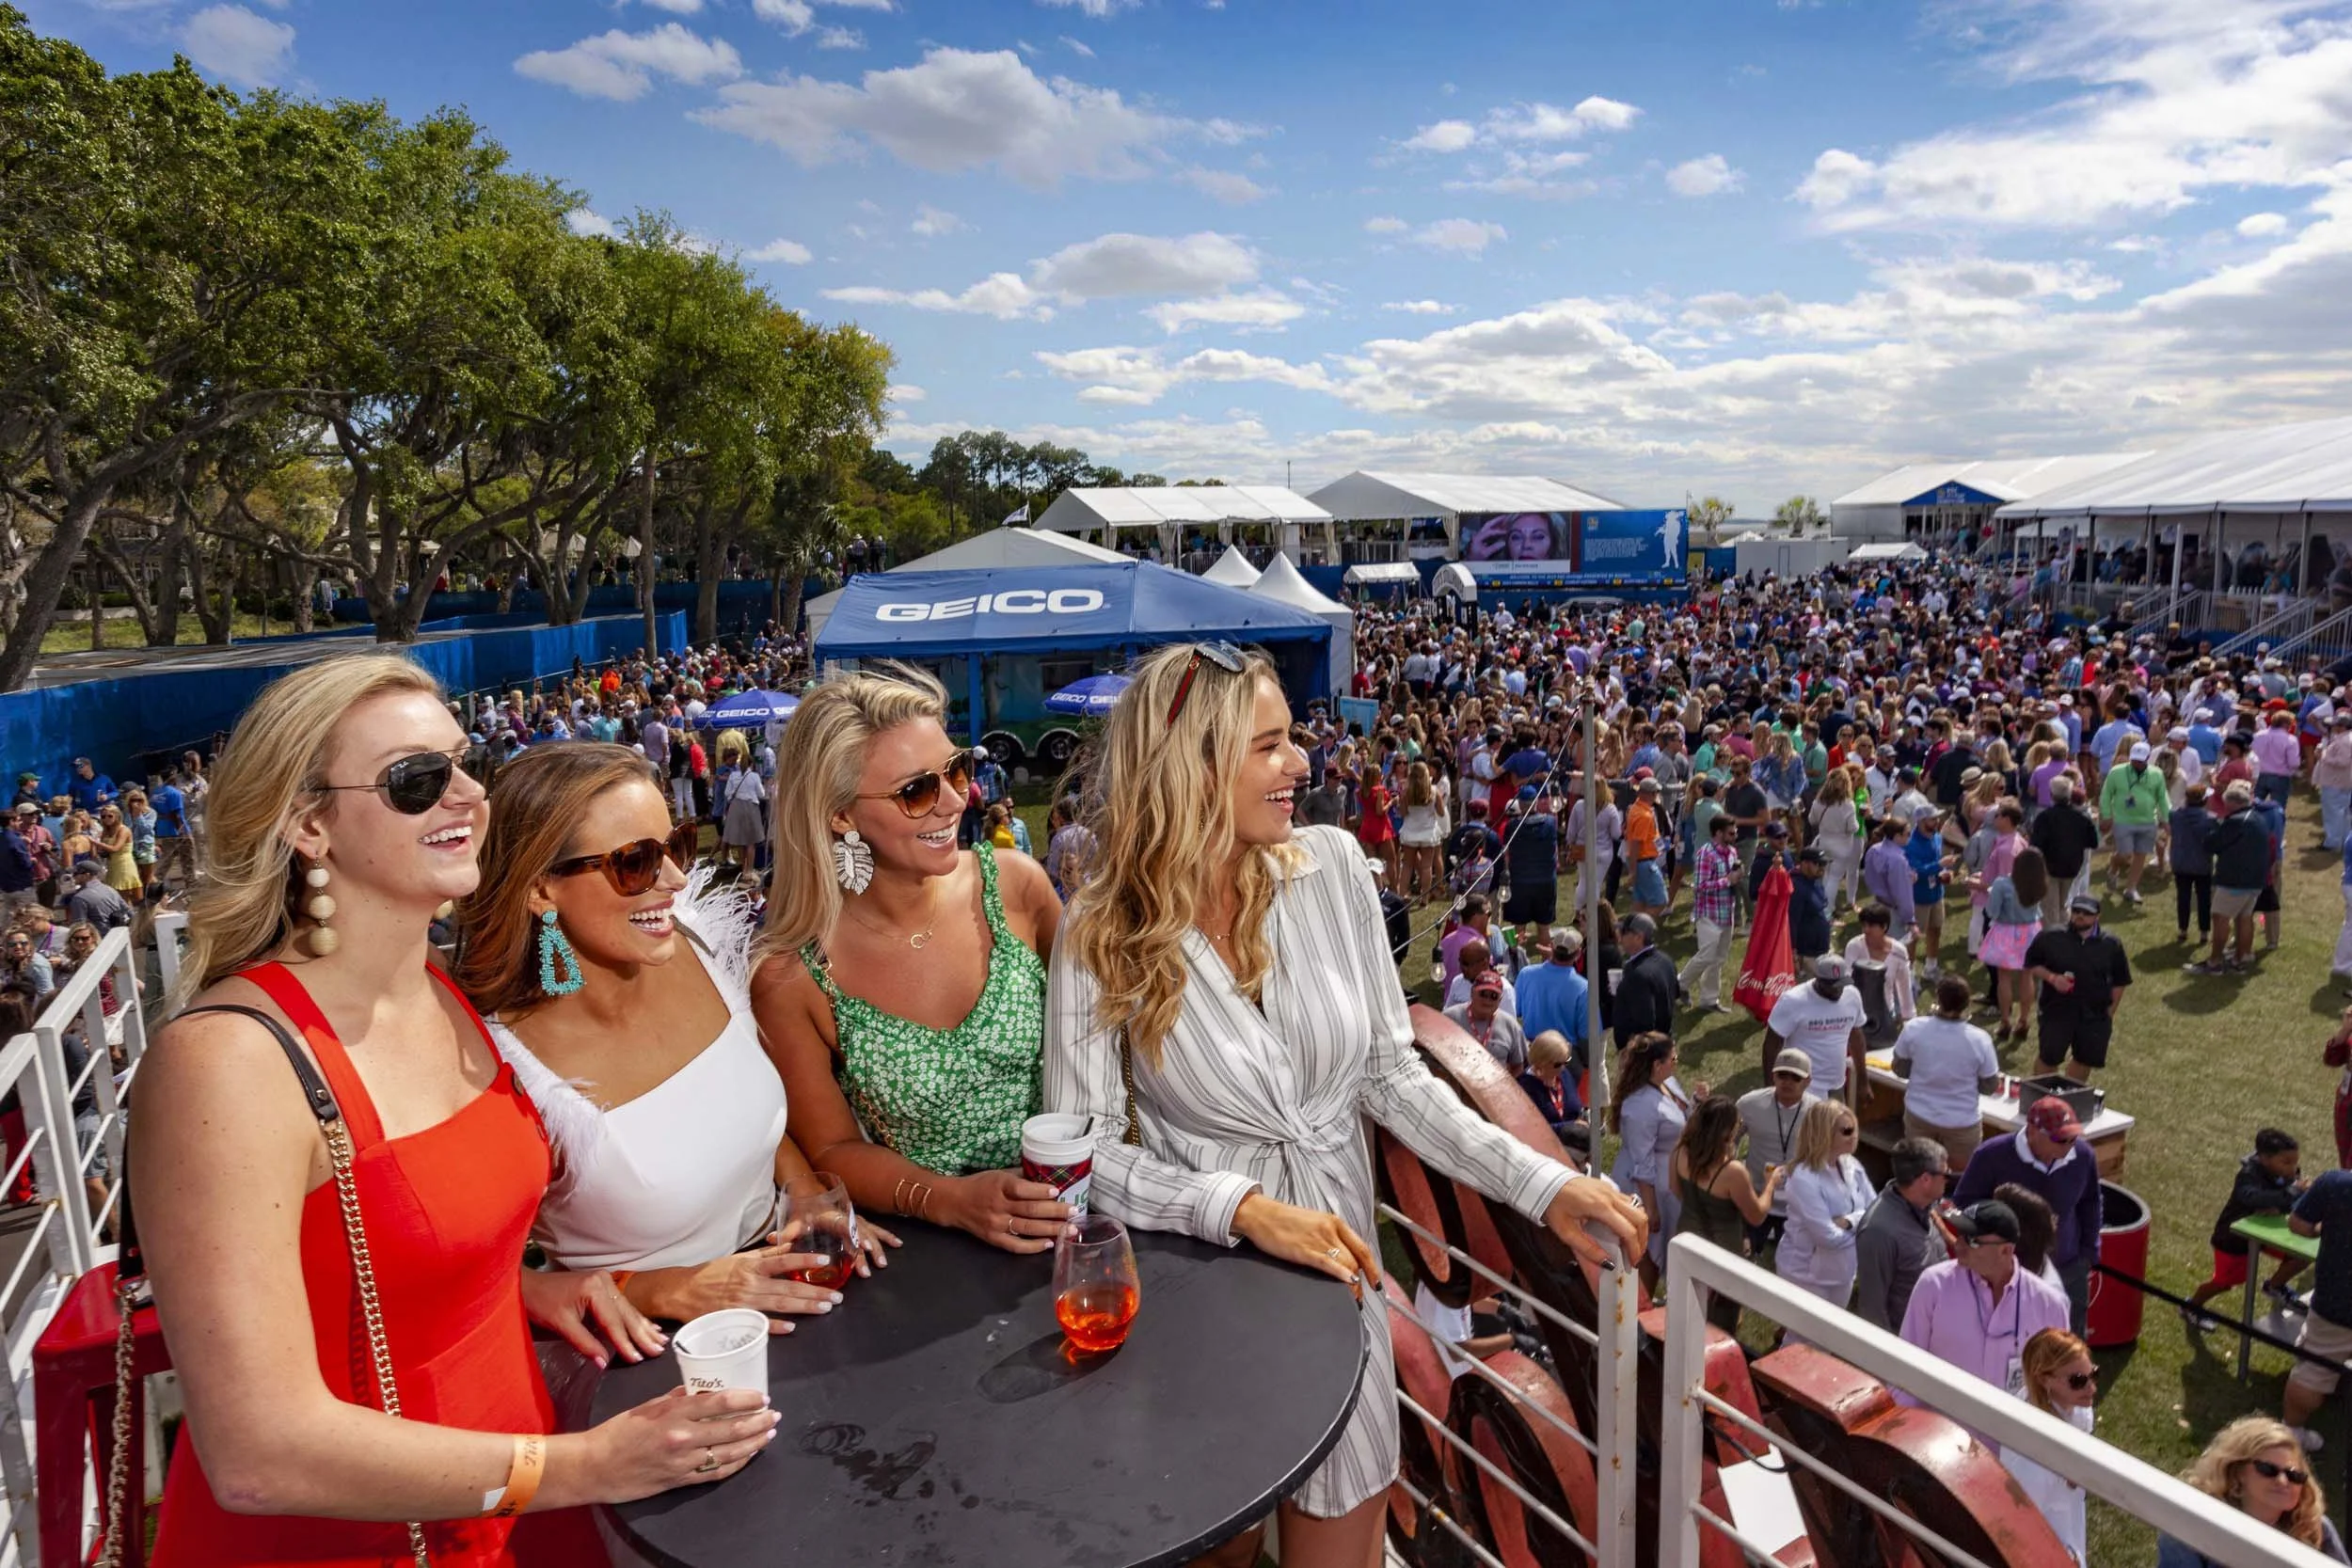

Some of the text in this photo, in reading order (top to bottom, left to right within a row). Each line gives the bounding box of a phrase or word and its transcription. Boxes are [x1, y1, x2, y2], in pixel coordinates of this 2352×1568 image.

[876, 589, 1104, 622] GEICO
[1051, 692, 1087, 704] GEICO
[716, 707, 770, 719] GEICO
